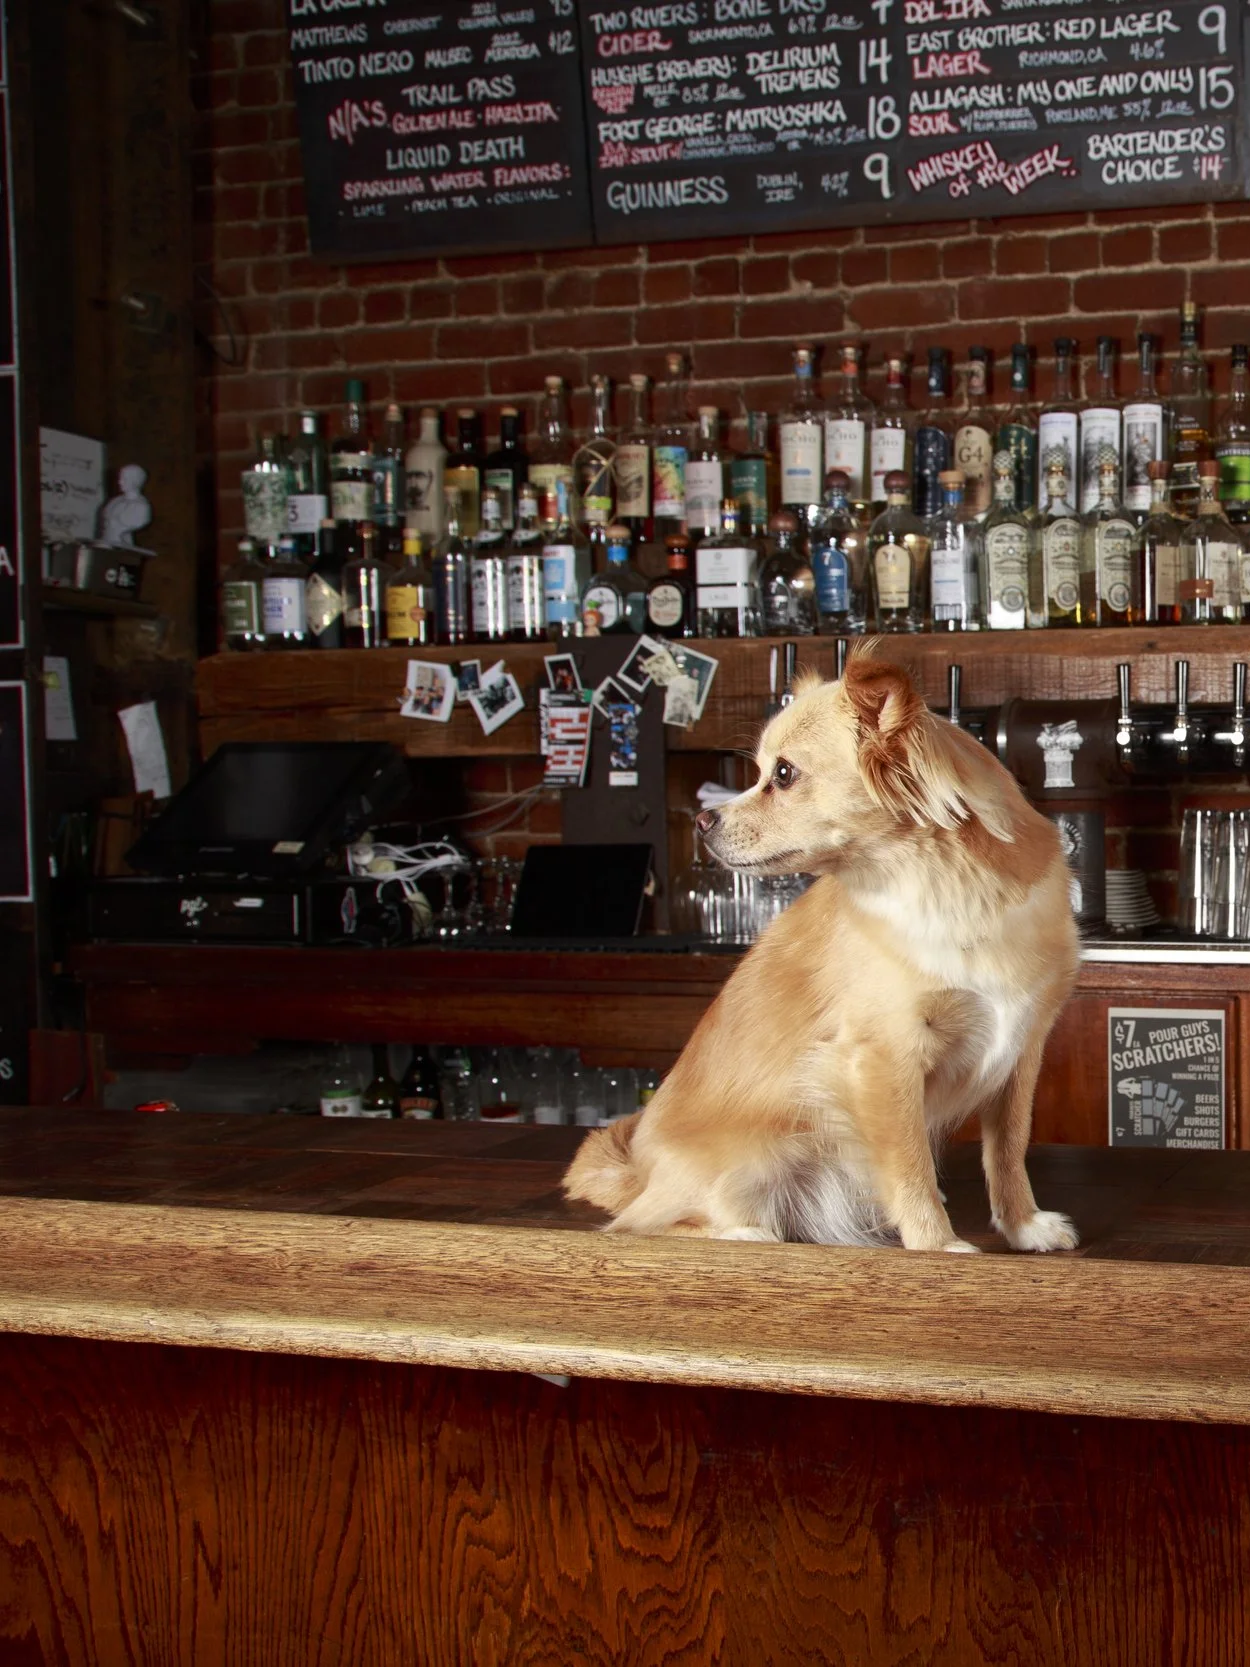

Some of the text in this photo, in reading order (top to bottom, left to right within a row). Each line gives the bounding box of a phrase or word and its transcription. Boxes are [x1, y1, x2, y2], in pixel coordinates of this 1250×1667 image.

[589, 13, 627, 34] TWO
[714, 0, 771, 21] BONE
[906, 32, 958, 54] EAST
[1053, 18, 1095, 42] RED
[1099, 9, 1181, 39] LAGER
[1197, 4, 1228, 54] 9
[290, 23, 368, 50] MATTHEWS
[598, 30, 672, 57] CIDER
[298, 46, 474, 84] TINTO NERO MALBEC
[590, 66, 654, 88] HUYGHE
[745, 42, 842, 75] DELIRIUM
[754, 37, 893, 95] TREMENS 14
[912, 51, 991, 80] LAGER
[400, 74, 516, 108] TRAIL PASS
[1017, 80, 1050, 103] MY
[1053, 75, 1101, 102] ONE
[1102, 72, 1138, 94] AND
[1140, 66, 1194, 93] ONLY
[1199, 64, 1236, 110] 15
[448, 109, 475, 129] ALE
[598, 118, 645, 143] FORT
[725, 99, 847, 133] MATRYOSHKA
[868, 95, 901, 140] 18
[908, 111, 960, 137] SOUR
[386, 135, 525, 170] LIQUID DEATH
[1088, 126, 1227, 159] BARTENDER'S
[907, 140, 998, 192] WHISKEY
[1101, 154, 1184, 185] CHOICE
[343, 176, 424, 200] SPARKLING
[430, 169, 487, 194] WATER
[606, 175, 729, 214] GUINNESS
[863, 152, 895, 199] 9
[949, 172, 973, 198] of
[353, 188, 559, 217] LIME PEACH TEA ORIGINAL
[958, 445, 984, 464] G4
[1114, 1020, 1136, 1048] $7
[1148, 1027, 1179, 1044] POUR
[1180, 1020, 1210, 1036] GUYS
[1112, 1033, 1221, 1071] SCRATCHERS!
[1188, 1064, 1211, 1072] CHANCE
[1194, 1106, 1220, 1115] SHOTS
[1195, 1094, 1219, 1104] BEERS
[1133, 1100, 1142, 1136] SCRATCHER
[1175, 1127, 1220, 1138] GIFT CARDS
[1183, 1117, 1220, 1127] BURGERS
[1166, 1139, 1220, 1150] MERCHANDISE
